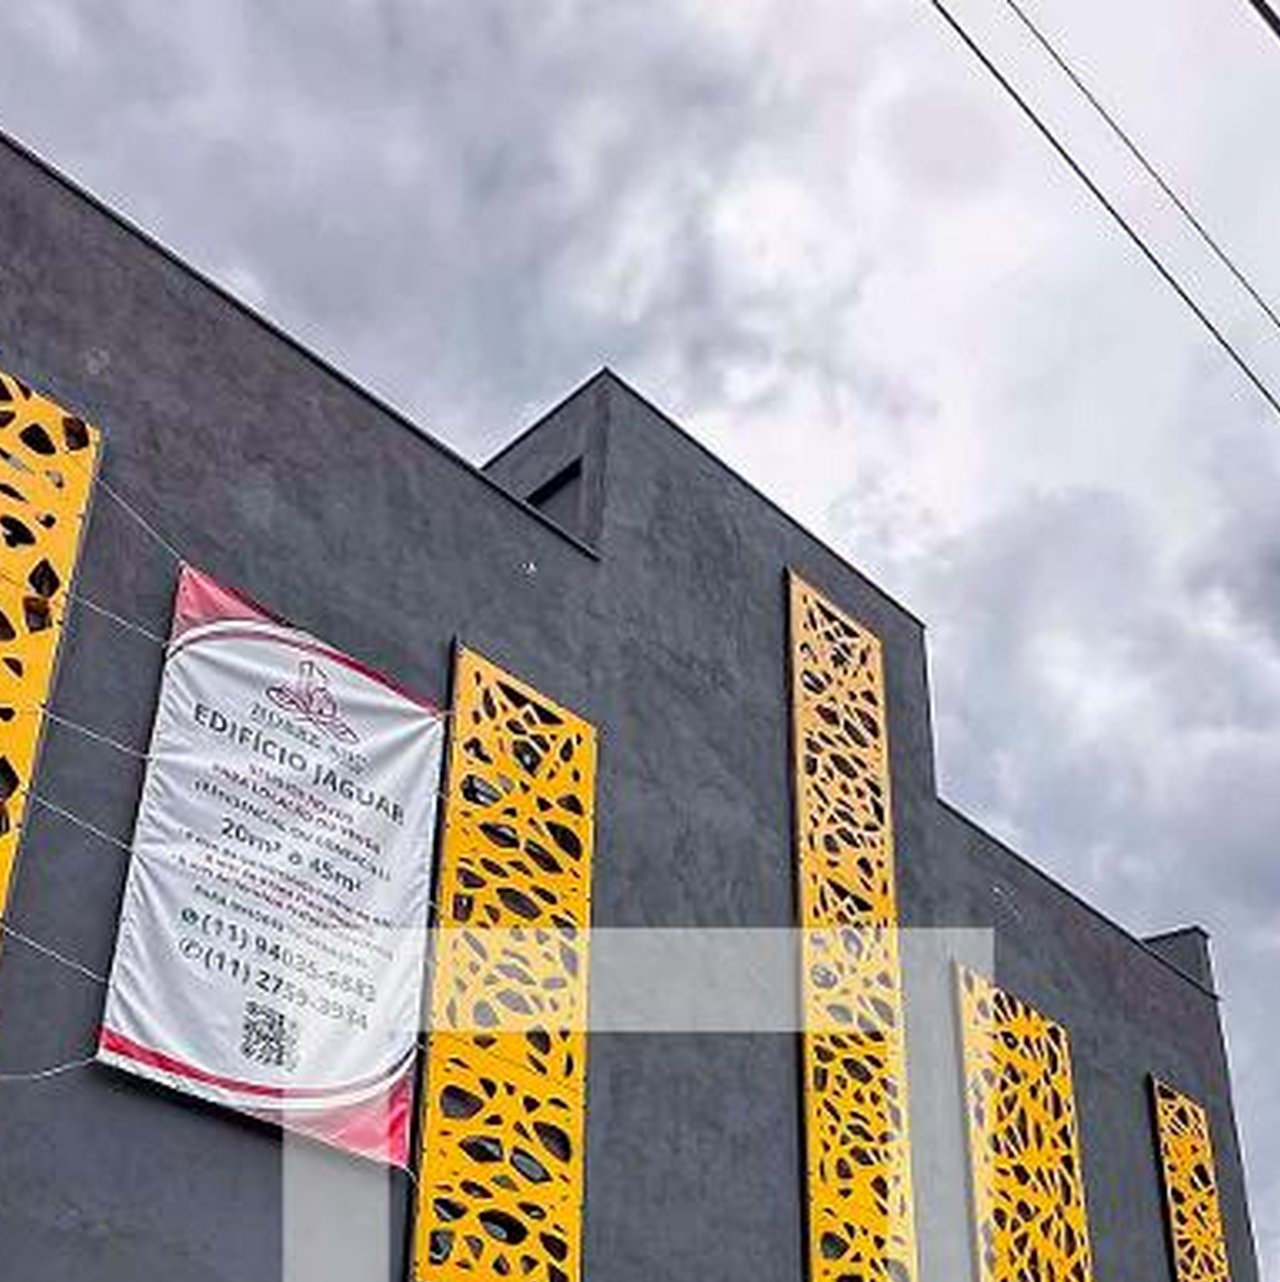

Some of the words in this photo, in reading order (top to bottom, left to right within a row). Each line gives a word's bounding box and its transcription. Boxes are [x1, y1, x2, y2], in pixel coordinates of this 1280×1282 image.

[193, 702, 307, 775] EDIFÍCIO
[311, 762, 405, 827] JAGUAR
[200, 911, 249, 953] (11)
[203, 944, 251, 986] (11)
